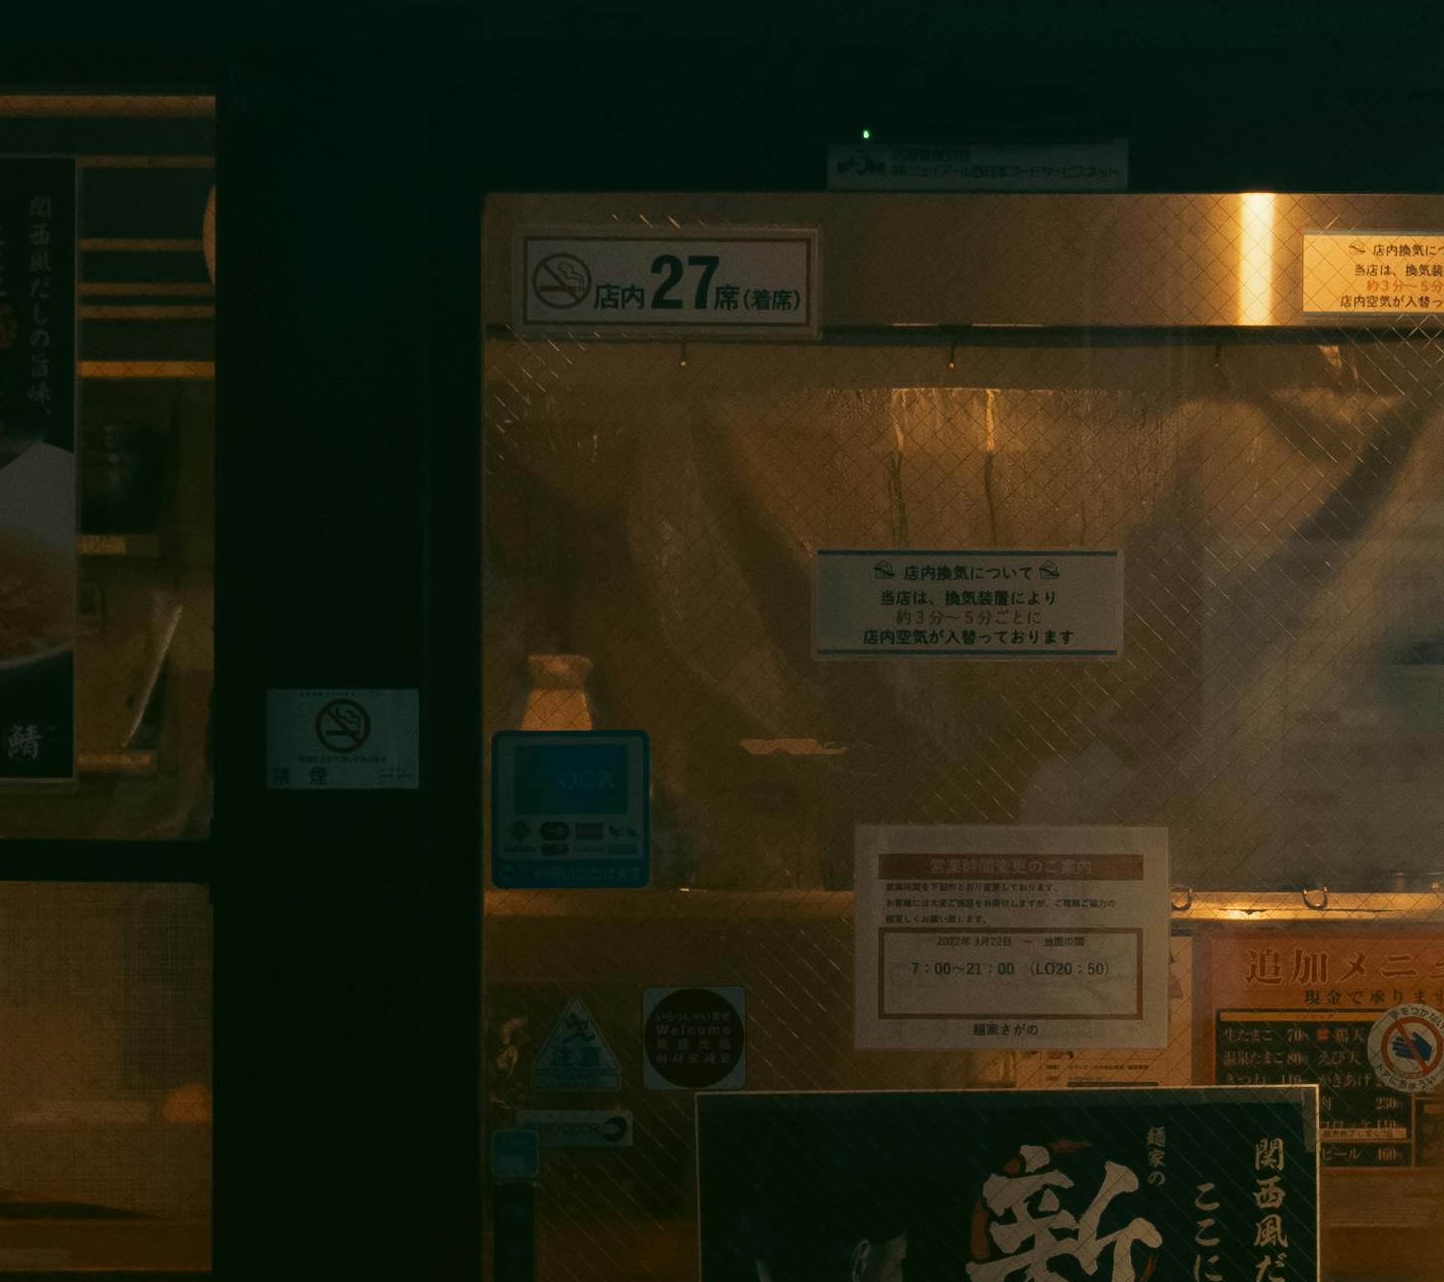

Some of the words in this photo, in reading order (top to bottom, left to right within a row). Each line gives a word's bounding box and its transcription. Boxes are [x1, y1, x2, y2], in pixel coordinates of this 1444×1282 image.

[28, 195, 54, 419] 関西風だしの旨味、
[903, 564, 1033, 582] 店内換気について
[880, 589, 1057, 606] 当店は、換気装置により
[863, 629, 1075, 646] 店内空気が入替っております
[930, 858, 1092, 876] 営業時間変更のご案内
[655, 1024, 733, 1037] Welcome
